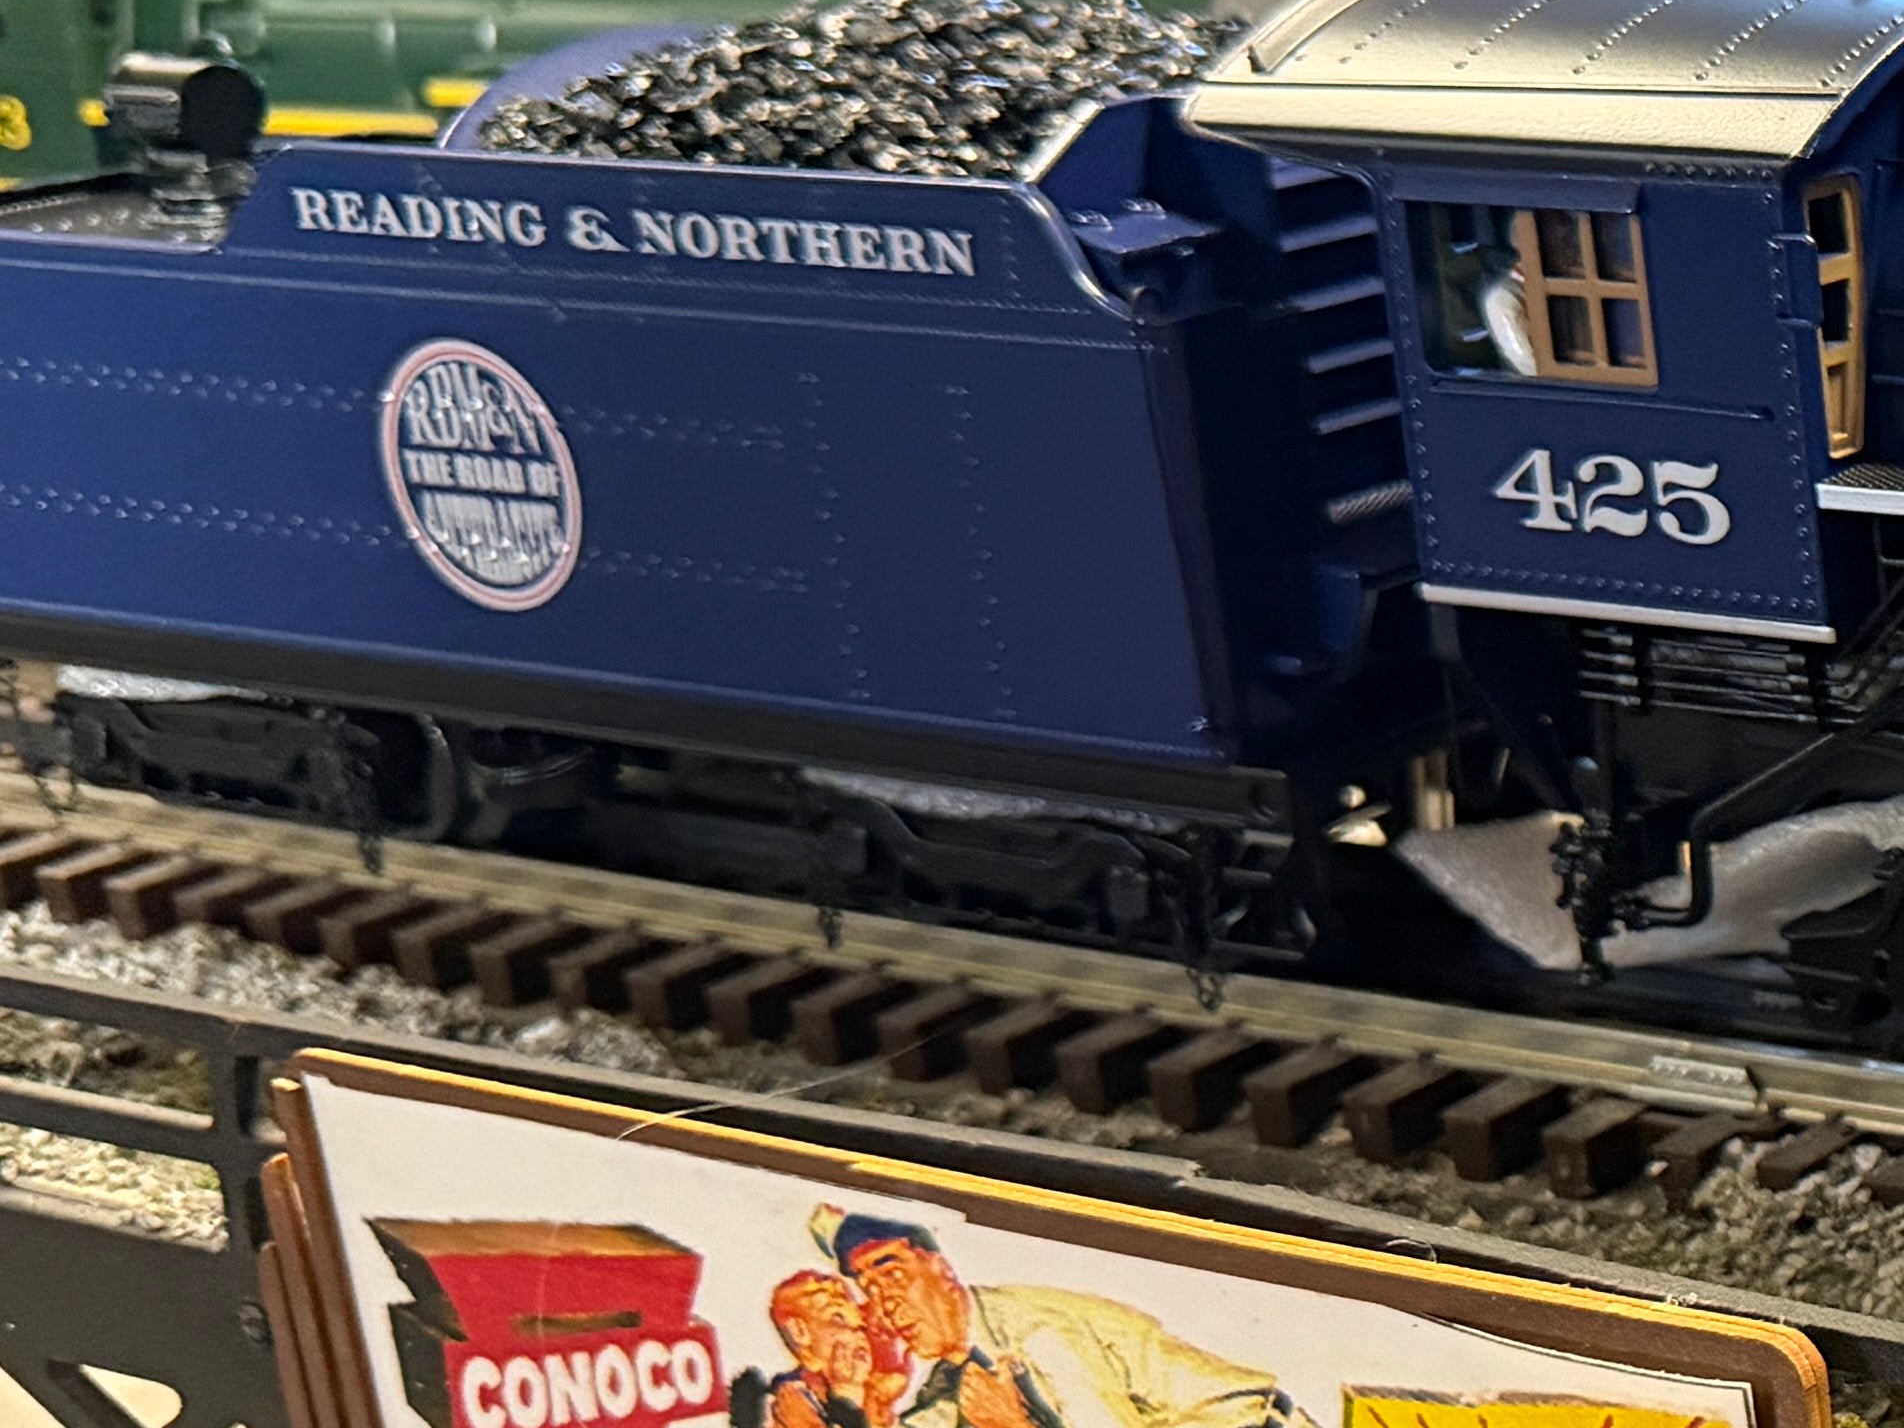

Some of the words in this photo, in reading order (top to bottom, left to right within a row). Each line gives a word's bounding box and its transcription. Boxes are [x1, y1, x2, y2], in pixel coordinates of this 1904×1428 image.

[289, 186, 547, 248] READING
[566, 204, 632, 254] &
[631, 208, 976, 277] NORTHERN
[404, 448, 455, 487] THE
[454, 452, 527, 494] ROAD
[527, 459, 561, 498] OF
[1493, 448, 1731, 546] 425
